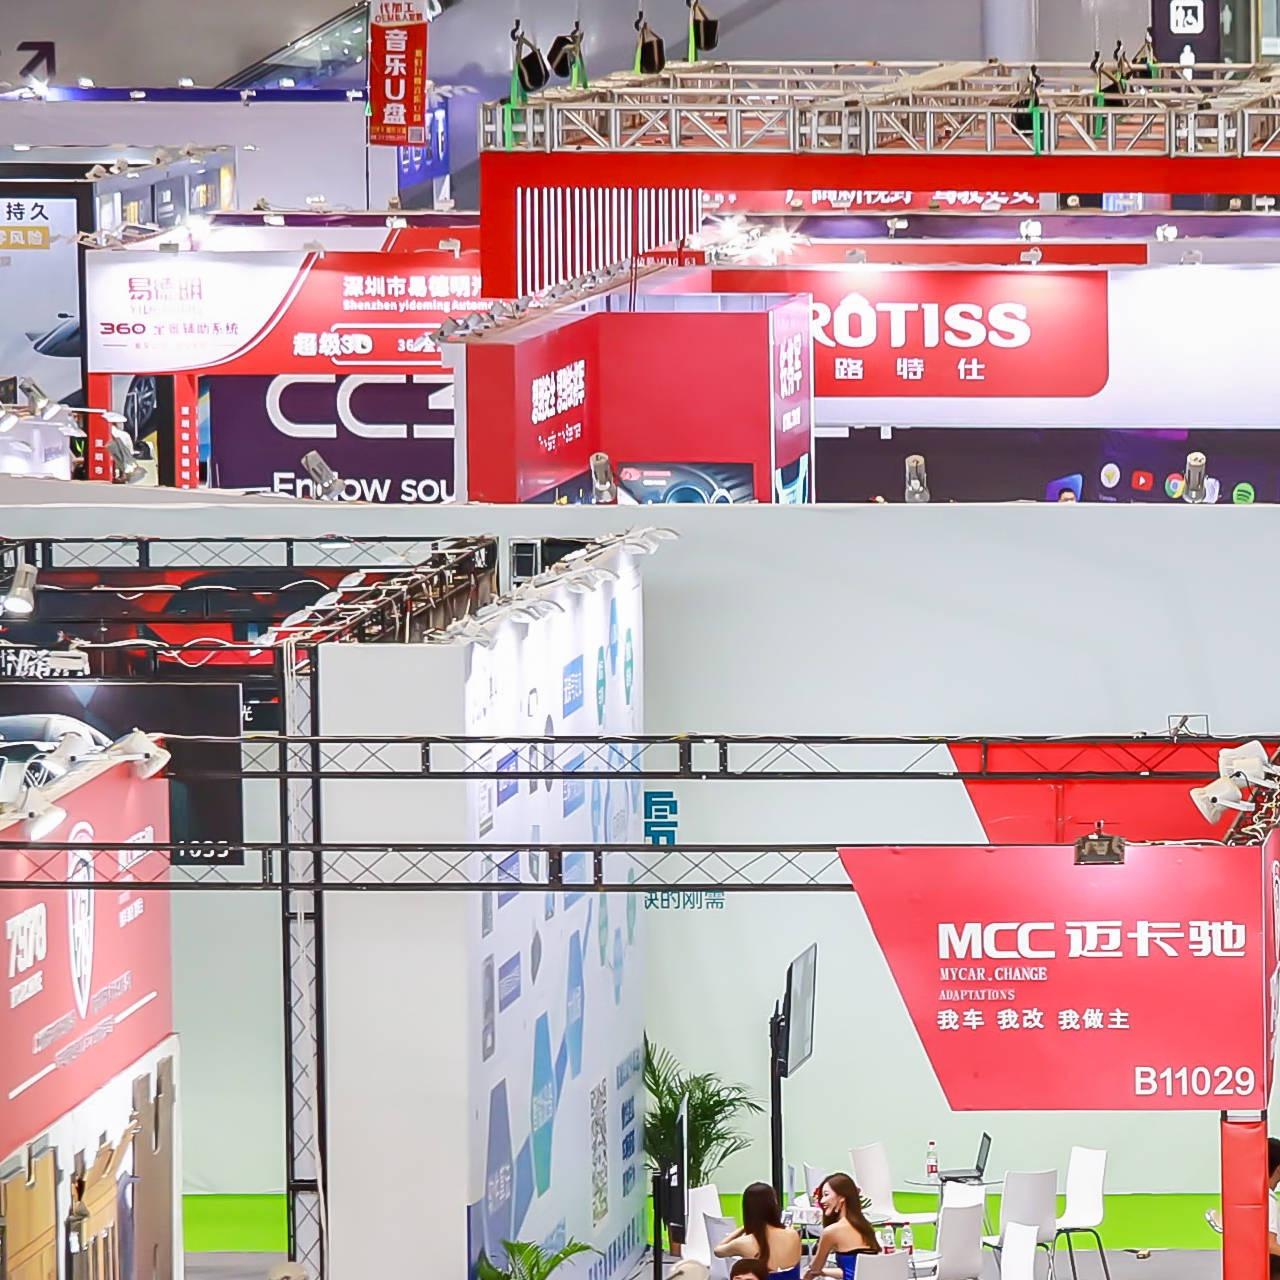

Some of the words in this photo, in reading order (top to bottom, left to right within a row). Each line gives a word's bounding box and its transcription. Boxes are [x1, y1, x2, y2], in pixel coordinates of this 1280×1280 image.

[383, 29, 407, 125] 音乐U盘
[6, 202, 49, 220] 持久
[100, 322, 146, 335] 360
[937, 921, 1056, 960] MCC
[1064, 919, 1247, 959] 迈卡驰
[939, 967, 1048, 982] MYCAR.CHANGE
[936, 1008, 985, 1031] 我车
[997, 1008, 1044, 1031] 我改
[1058, 1008, 1131, 1031] 我做主
[1134, 1066, 1256, 1097] B11029
